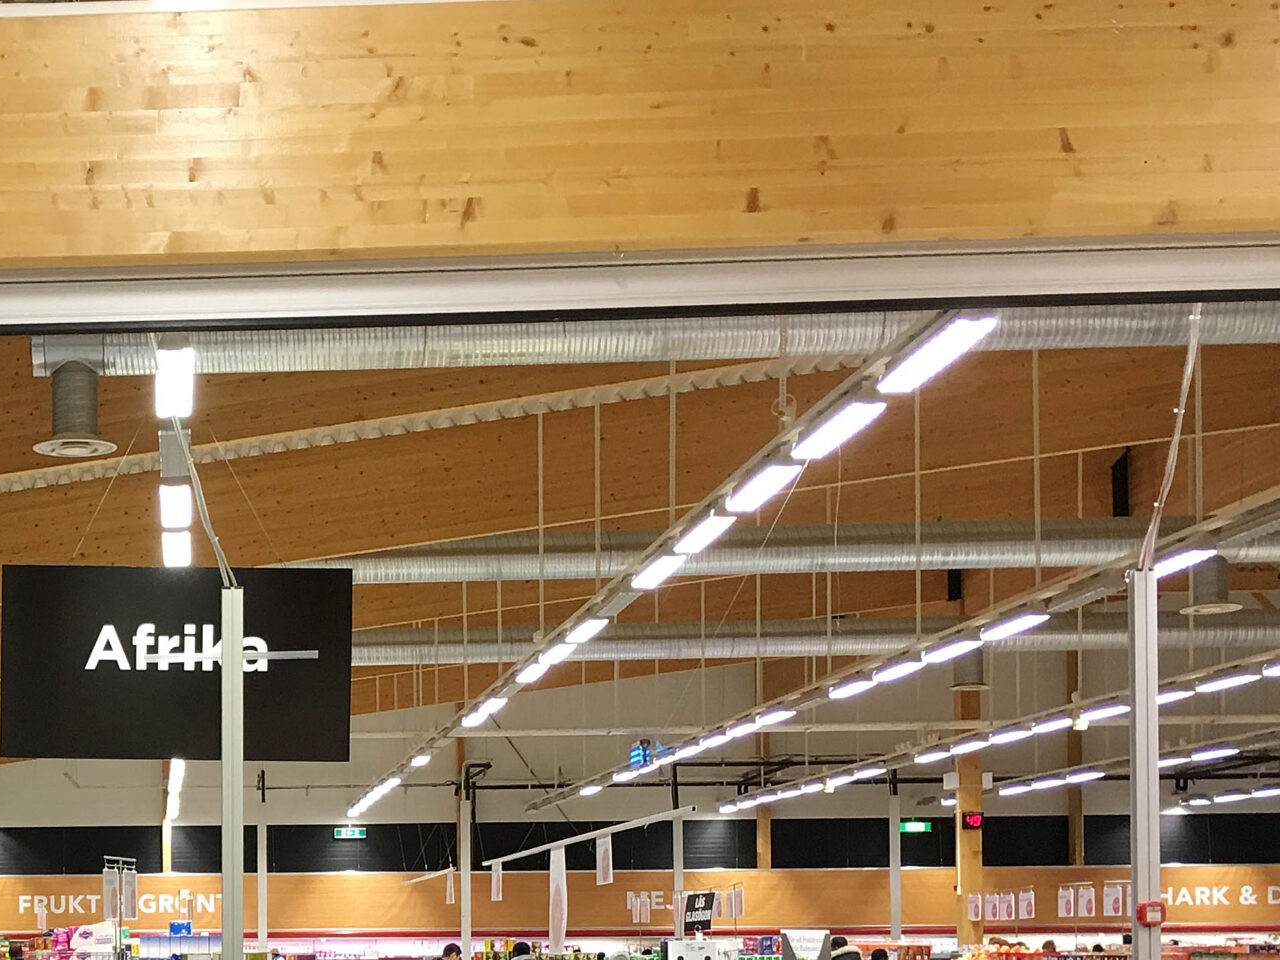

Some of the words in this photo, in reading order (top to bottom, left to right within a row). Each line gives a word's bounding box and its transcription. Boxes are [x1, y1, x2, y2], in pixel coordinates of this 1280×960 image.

[84, 623, 269, 672] Afrika
[18, 894, 102, 914] FRUKT
[138, 888, 222, 914] GRÖN
[1238, 885, 1258, 905] &
